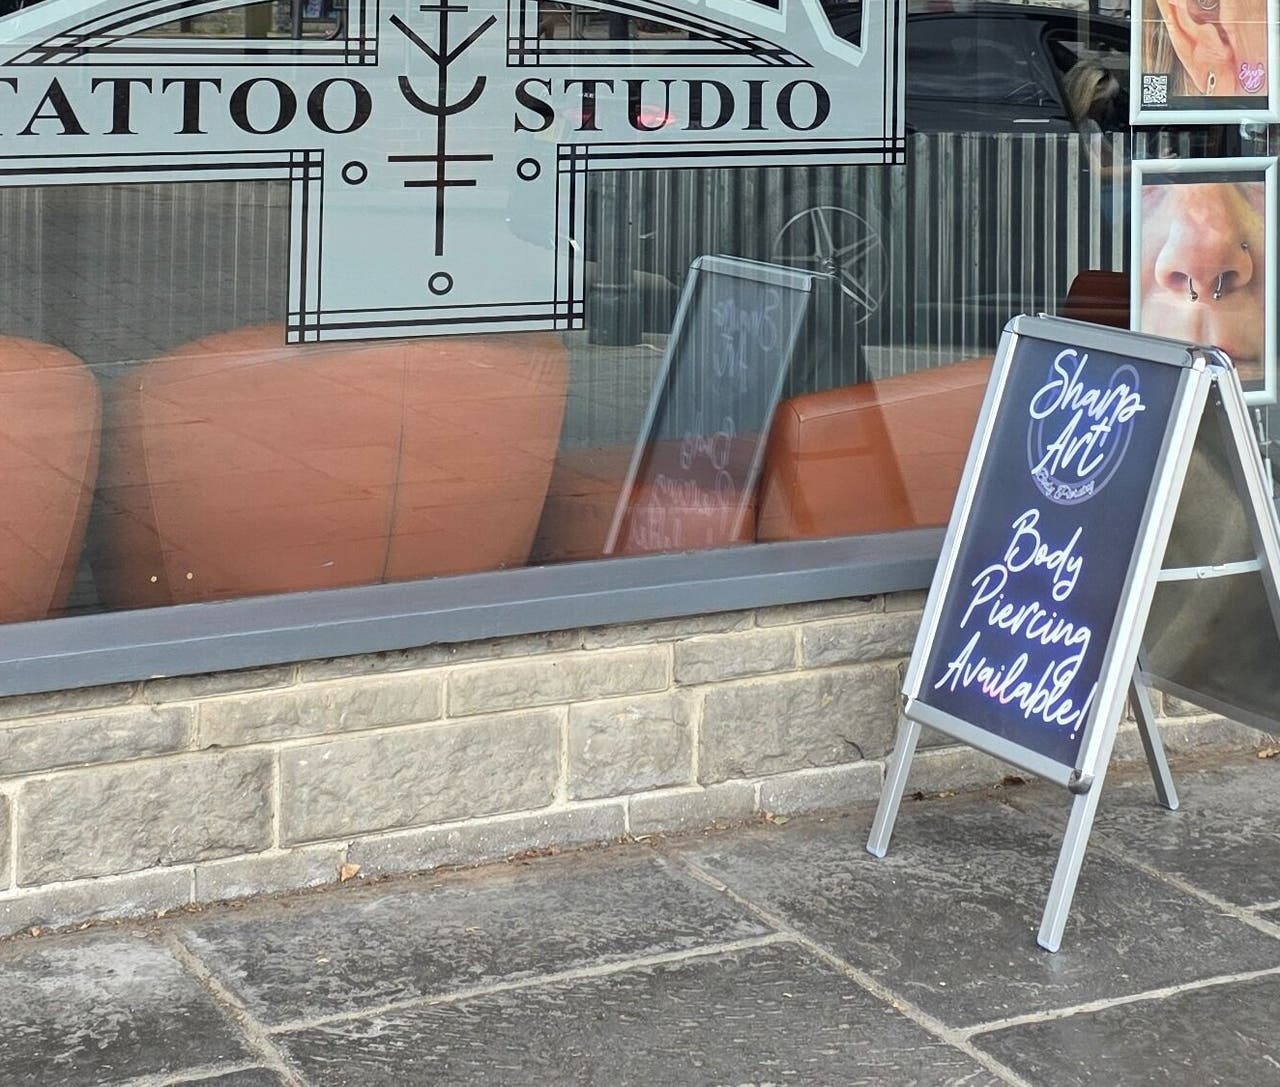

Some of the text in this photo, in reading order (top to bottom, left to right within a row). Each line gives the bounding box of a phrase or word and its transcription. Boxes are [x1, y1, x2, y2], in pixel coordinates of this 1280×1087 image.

[514, 77, 831, 134] STUDIO
[1029, 348, 1146, 427] Sharp
[1031, 416, 1111, 478] Art
[1003, 508, 1084, 602] Body
[959, 565, 1092, 686] Piercing
[934, 631, 1099, 740] Available!
